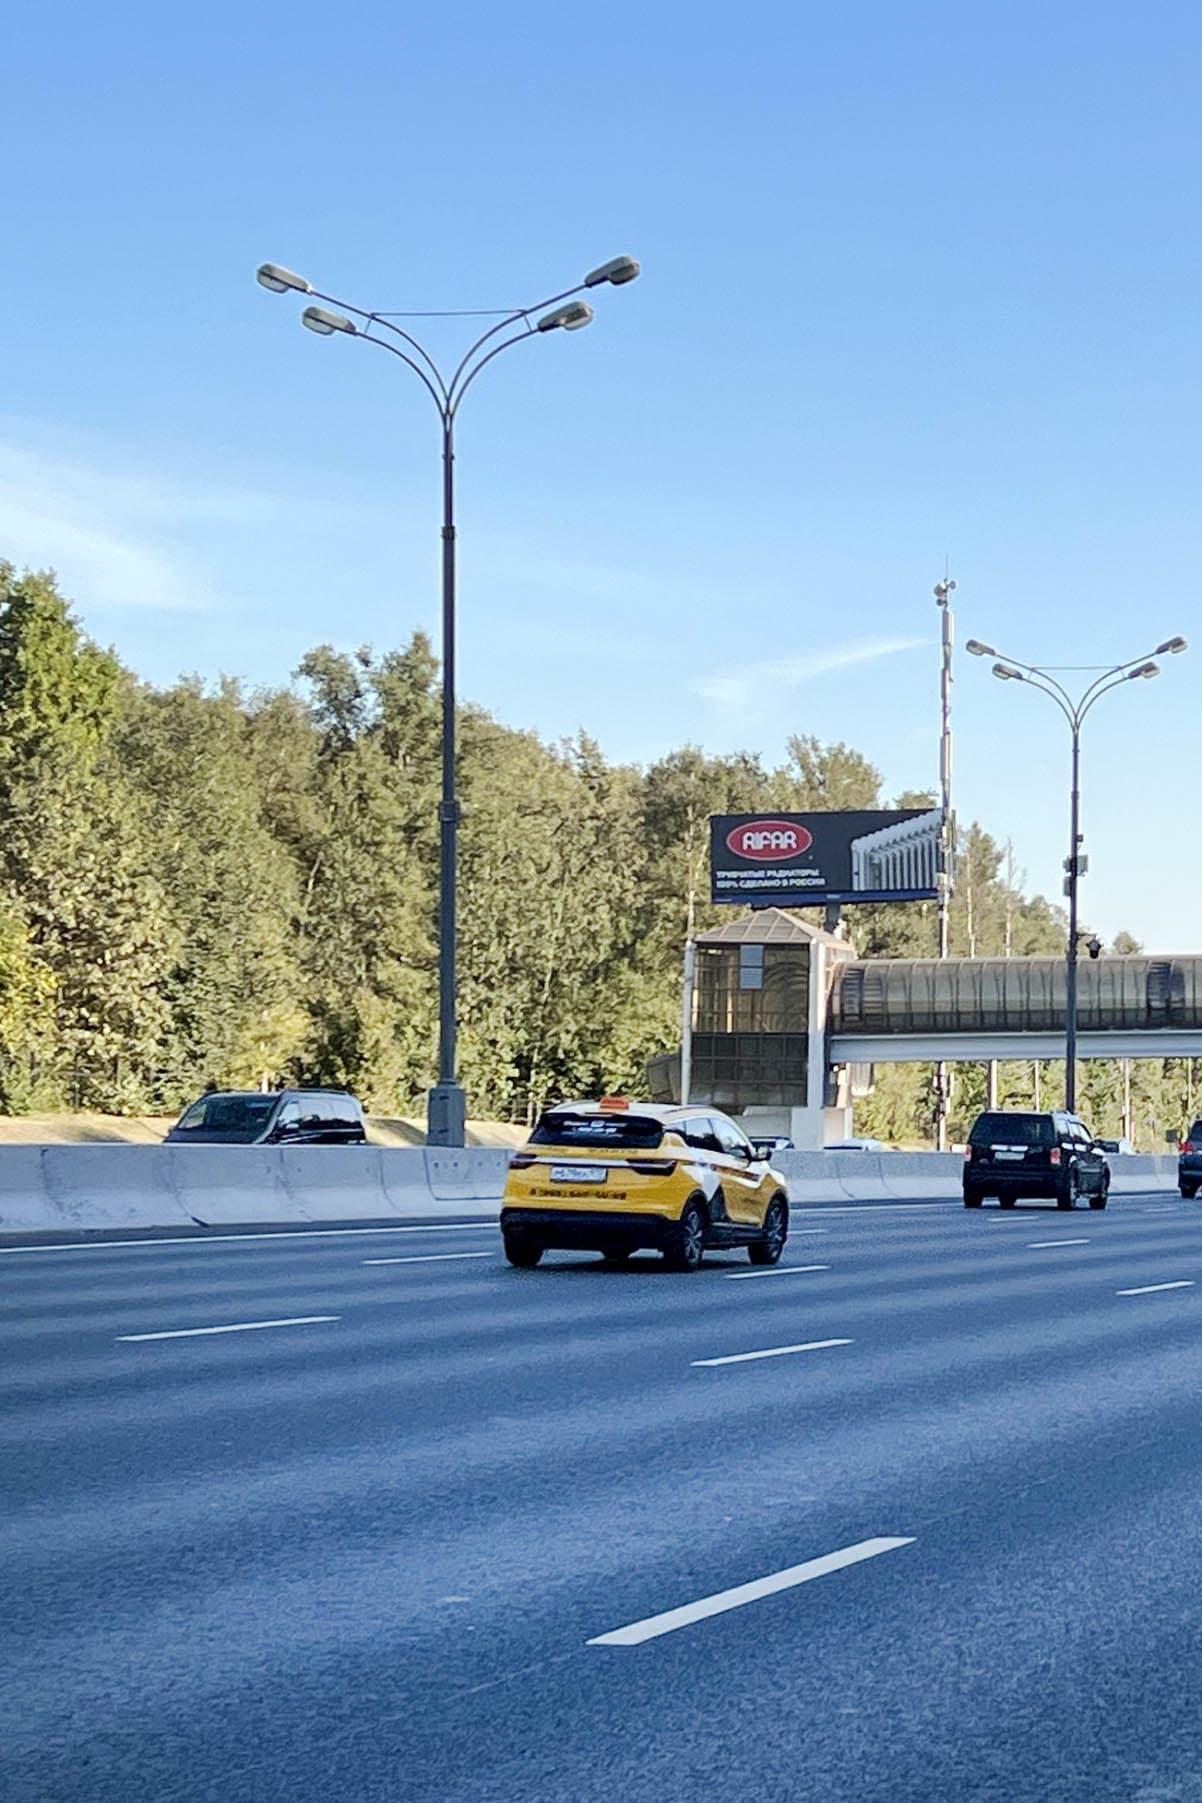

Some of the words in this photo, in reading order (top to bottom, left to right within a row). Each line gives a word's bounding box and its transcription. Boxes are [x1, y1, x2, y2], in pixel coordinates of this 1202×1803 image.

[742, 831, 797, 850] RIFAR
[739, 879, 781, 888] СДЕЛАНО
[789, 878, 825, 887] РОССИИ
